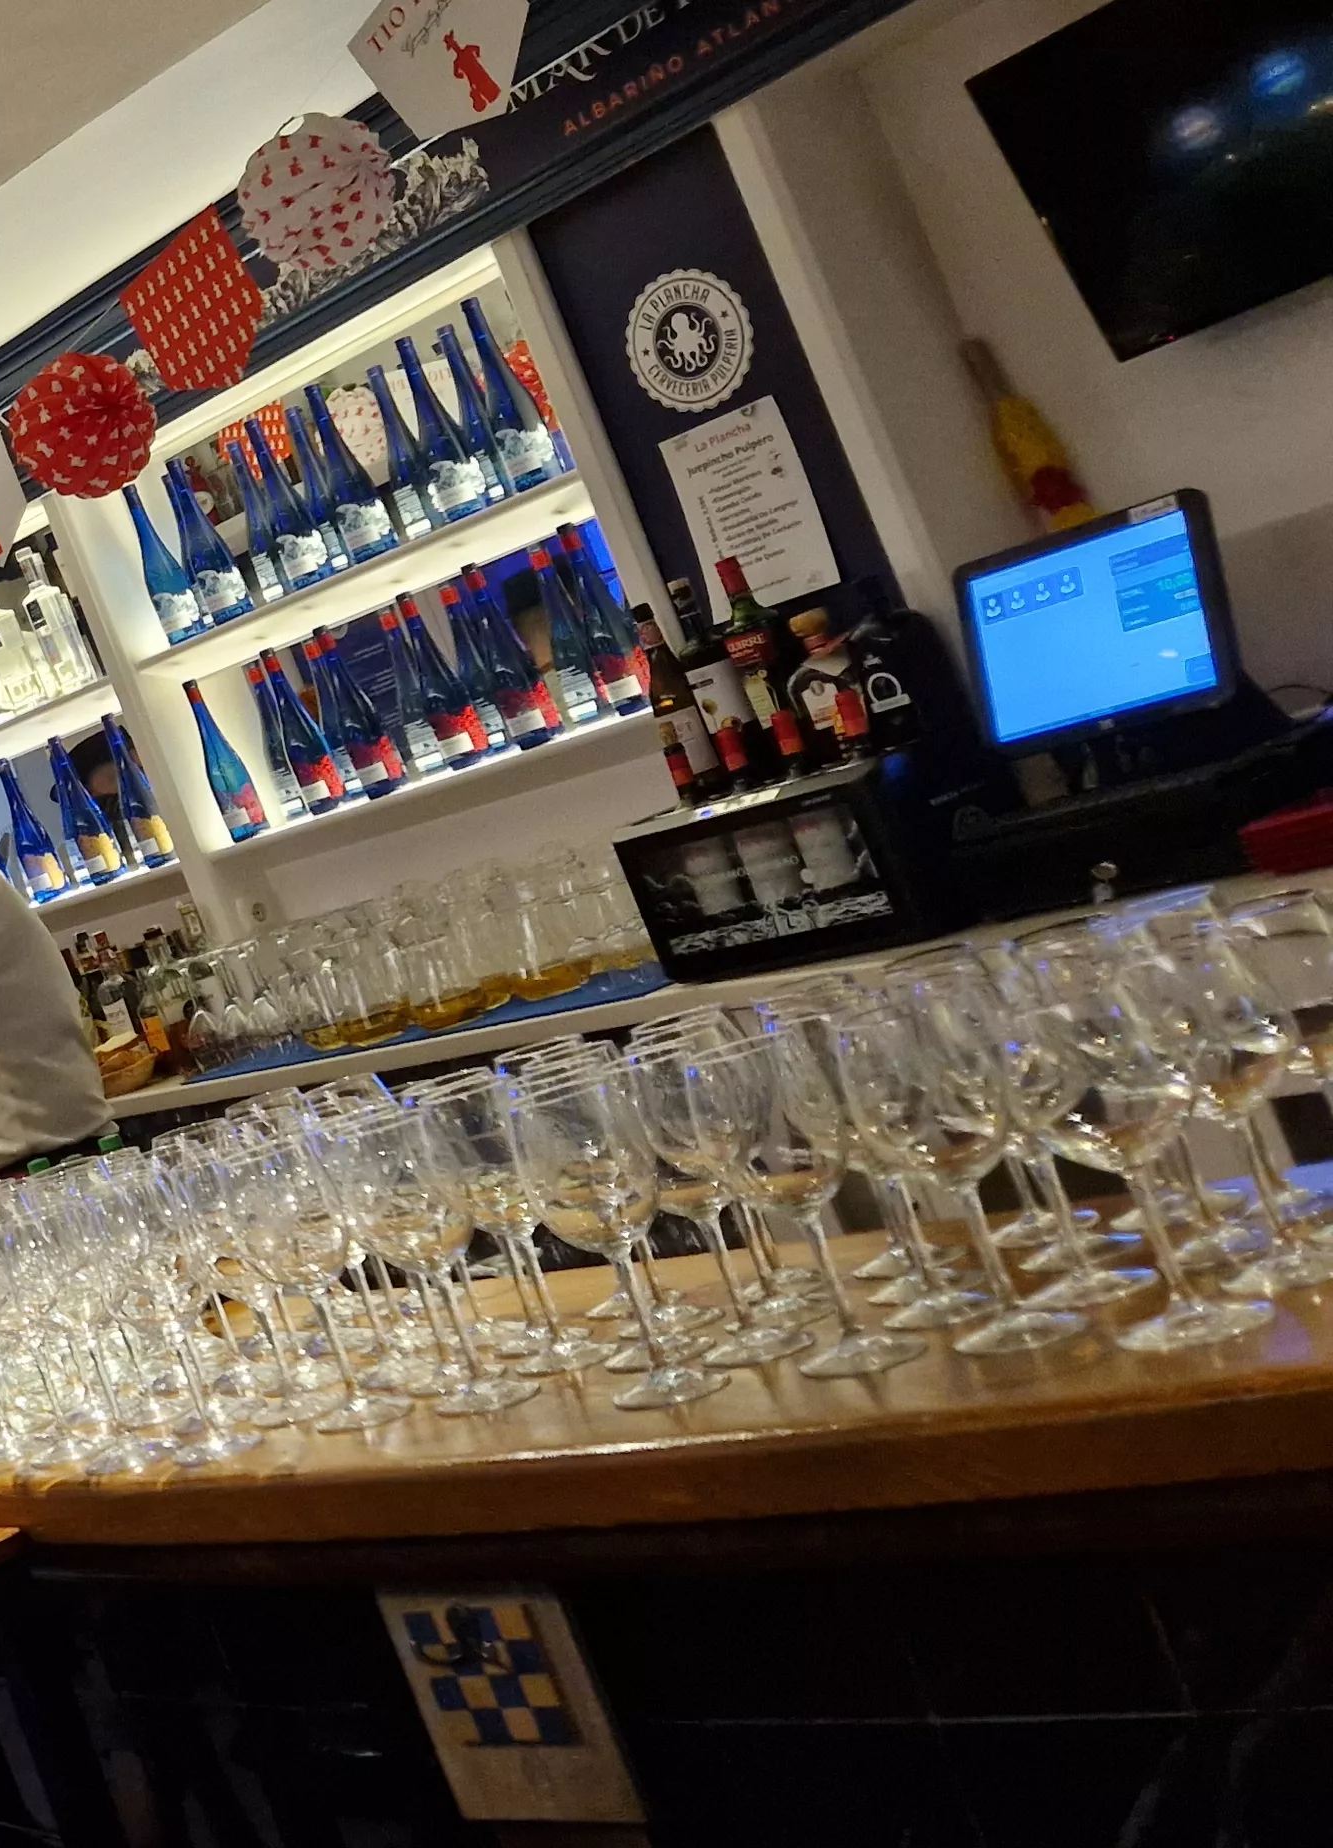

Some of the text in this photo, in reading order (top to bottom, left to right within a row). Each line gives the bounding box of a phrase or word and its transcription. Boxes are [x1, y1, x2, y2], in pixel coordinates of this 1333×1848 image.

[365, 6, 407, 55] TIO
[616, 8, 665, 45] DE
[564, 56, 683, 137] ALBARIÑO
[640, 283, 710, 331] LA PLANCHA
[709, 423, 752, 448] Plancha
